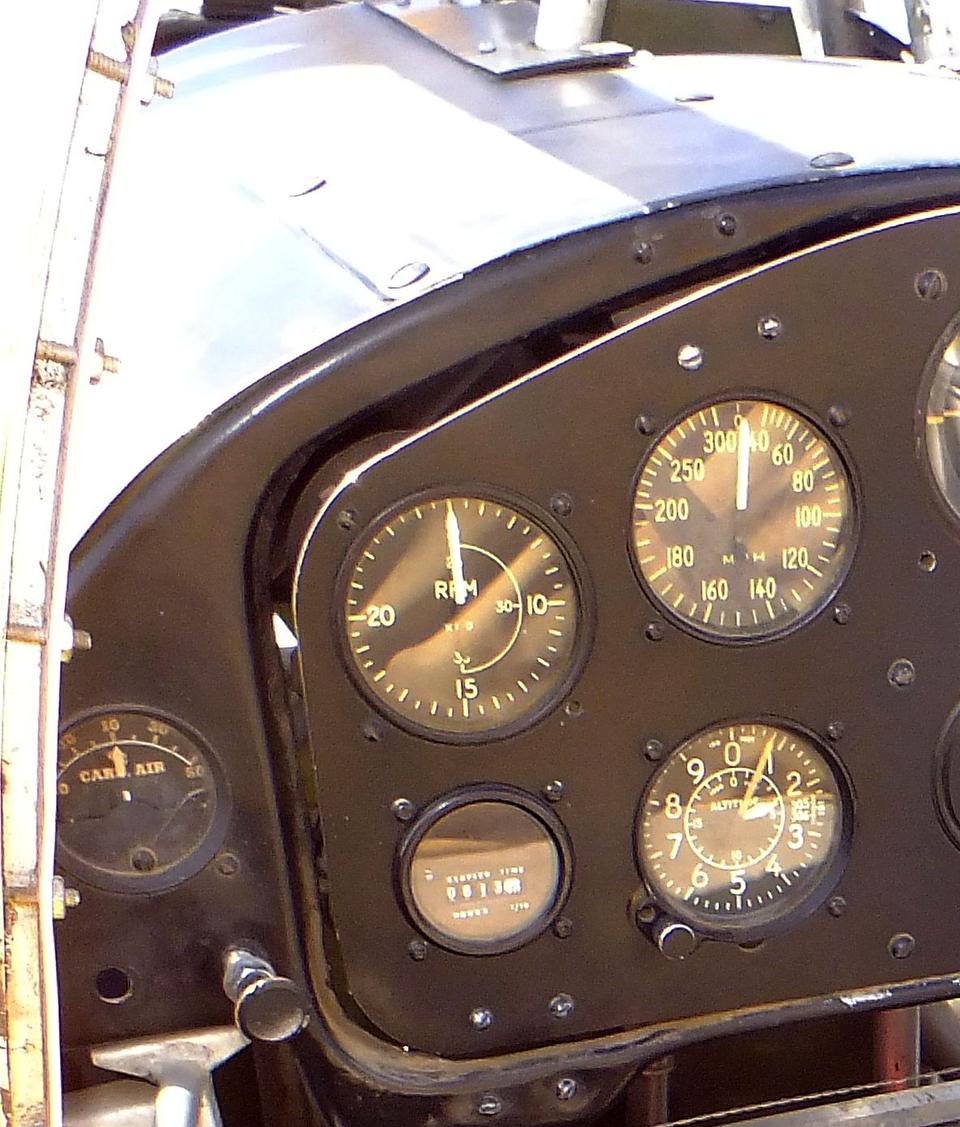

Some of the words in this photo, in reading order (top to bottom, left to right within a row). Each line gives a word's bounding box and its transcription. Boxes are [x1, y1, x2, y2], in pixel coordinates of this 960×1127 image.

[703, 430, 736, 453] 300
[772, 443, 793, 465] 60
[670, 458, 705, 482] 250
[792, 470, 814, 492] 80
[654, 498, 689, 522] 200
[795, 505, 822, 528] 100
[666, 545, 694, 568] 180
[782, 548, 808, 569] 120
[701, 578, 728, 600] 160
[750, 577, 776, 600] 140
[366, 604, 396, 626] 20
[526, 594, 548, 615] 10
[456, 678, 478, 699] 15
[724, 741, 741, 766] 0
[134, 761, 165, 776] AIR
[686, 758, 705, 784] 9
[786, 770, 802, 796] 2
[664, 793, 682, 819] 8
[666, 832, 683, 859] 7
[787, 823, 804, 850] 3
[691, 863, 709, 888] 6
[765, 853, 783, 877] 4
[730, 869, 747, 894] 5
